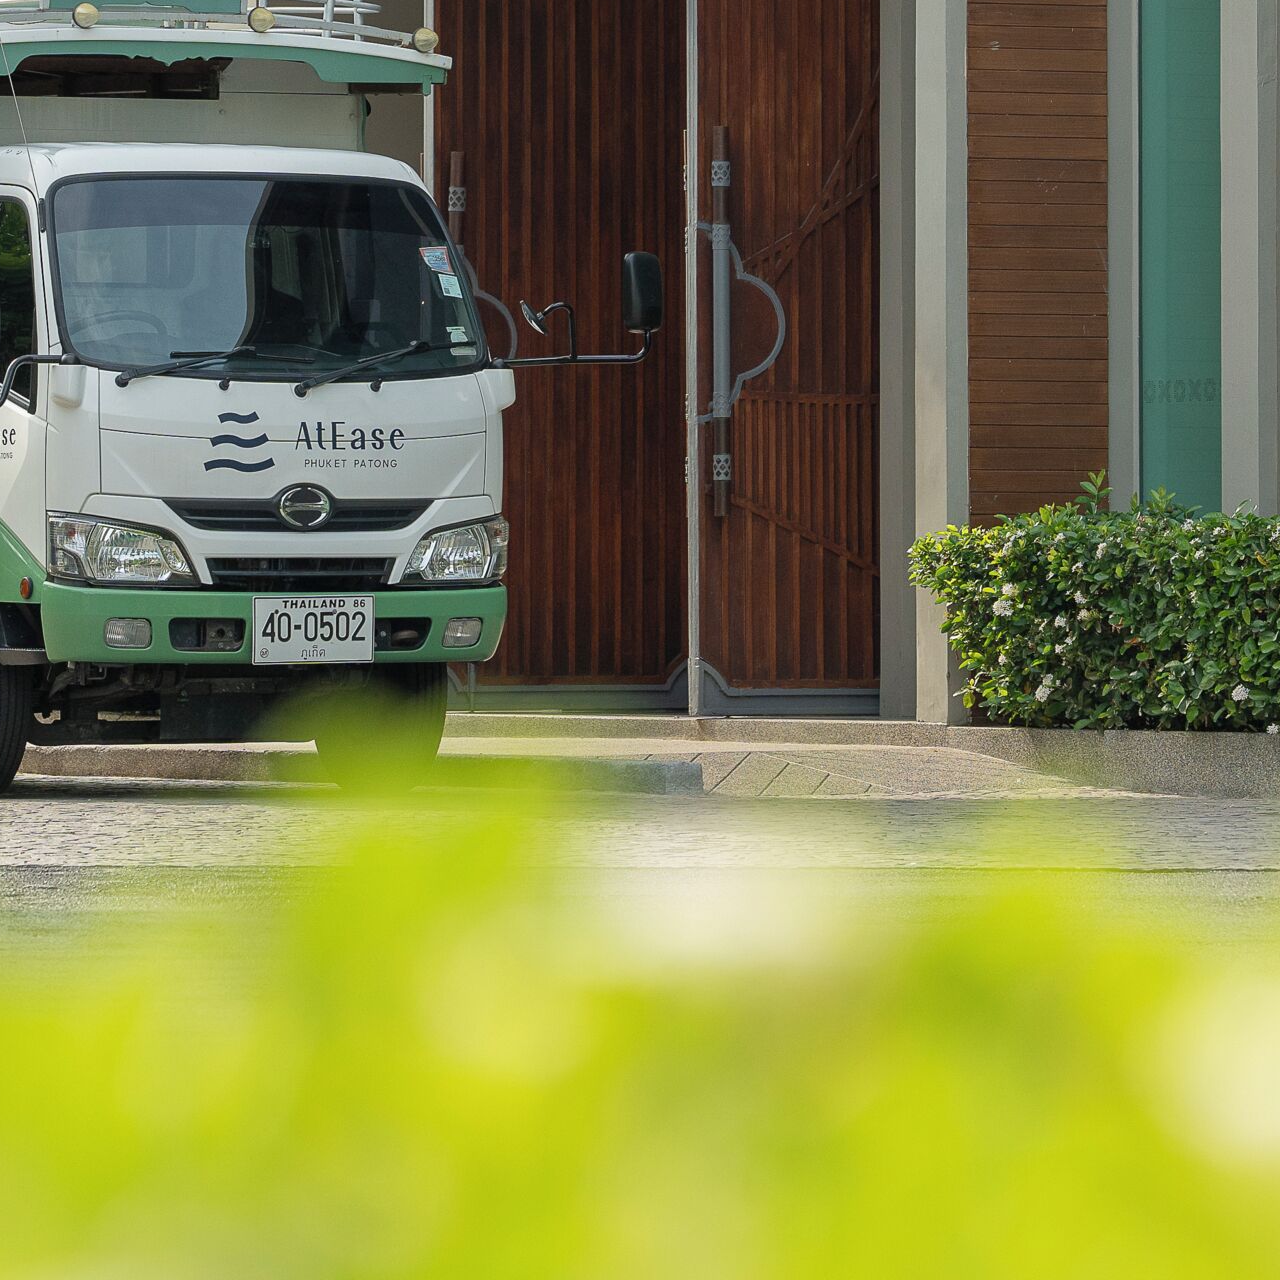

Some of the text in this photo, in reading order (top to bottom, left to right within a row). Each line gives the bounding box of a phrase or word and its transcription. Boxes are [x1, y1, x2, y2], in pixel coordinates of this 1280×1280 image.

[295, 421, 405, 450] AtEase
[304, 458, 398, 468] PHUKET PATONG
[282, 599, 366, 609] THAILAND 86
[262, 610, 366, 643] 40-0502
[300, 645, 326, 660] ภูเก็ต
